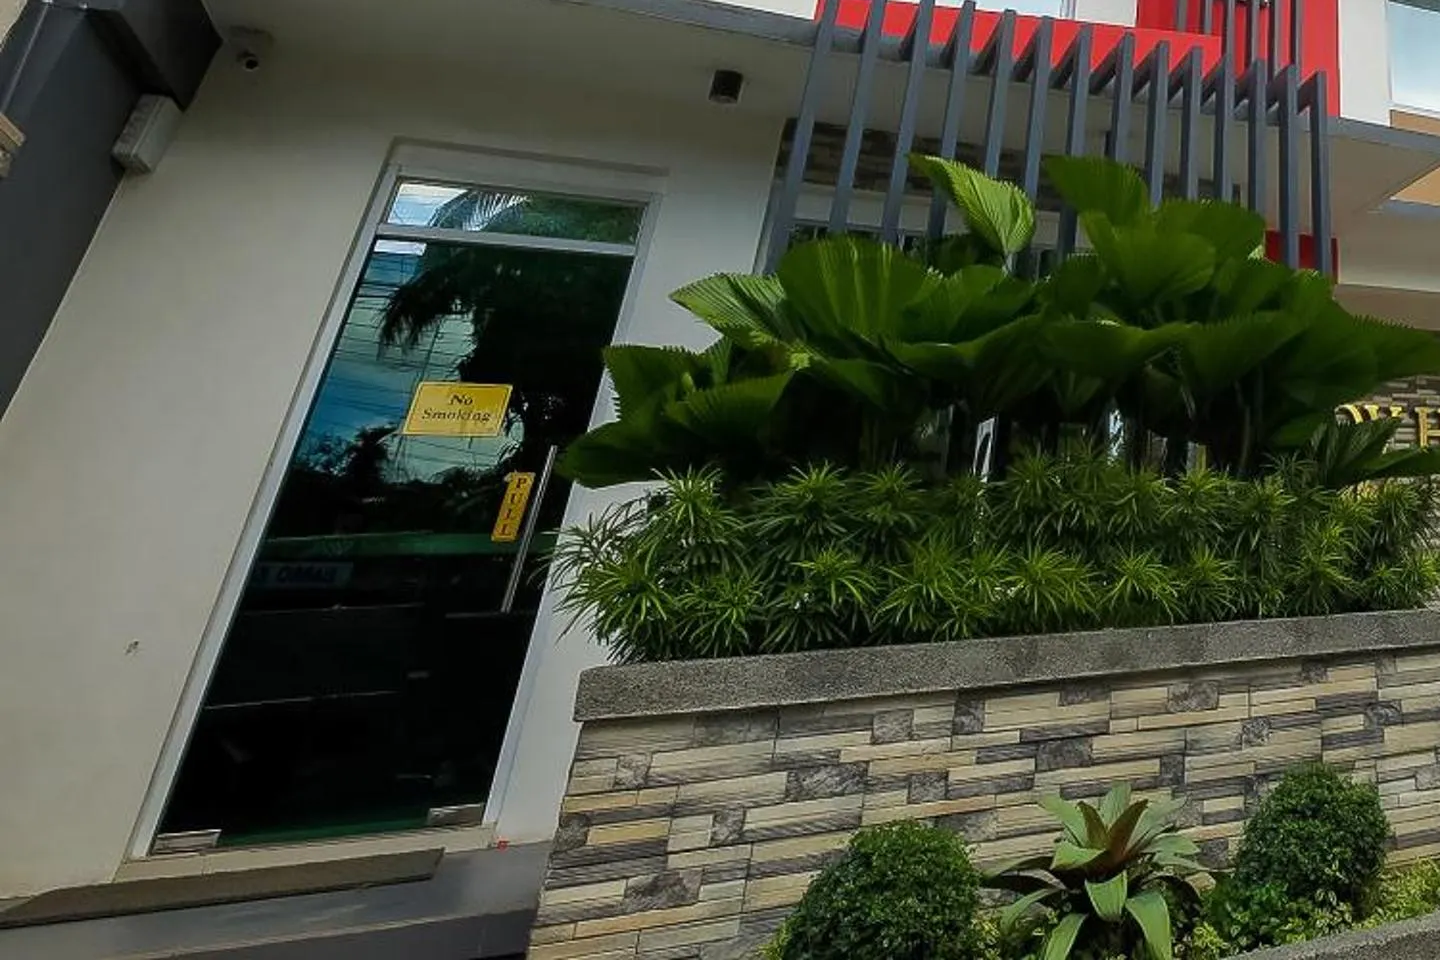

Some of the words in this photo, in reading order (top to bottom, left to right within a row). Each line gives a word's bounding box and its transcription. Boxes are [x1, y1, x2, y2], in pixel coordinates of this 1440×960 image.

[449, 393, 473, 407] No
[421, 407, 492, 422] Smoking
[500, 477, 528, 536] PULL
